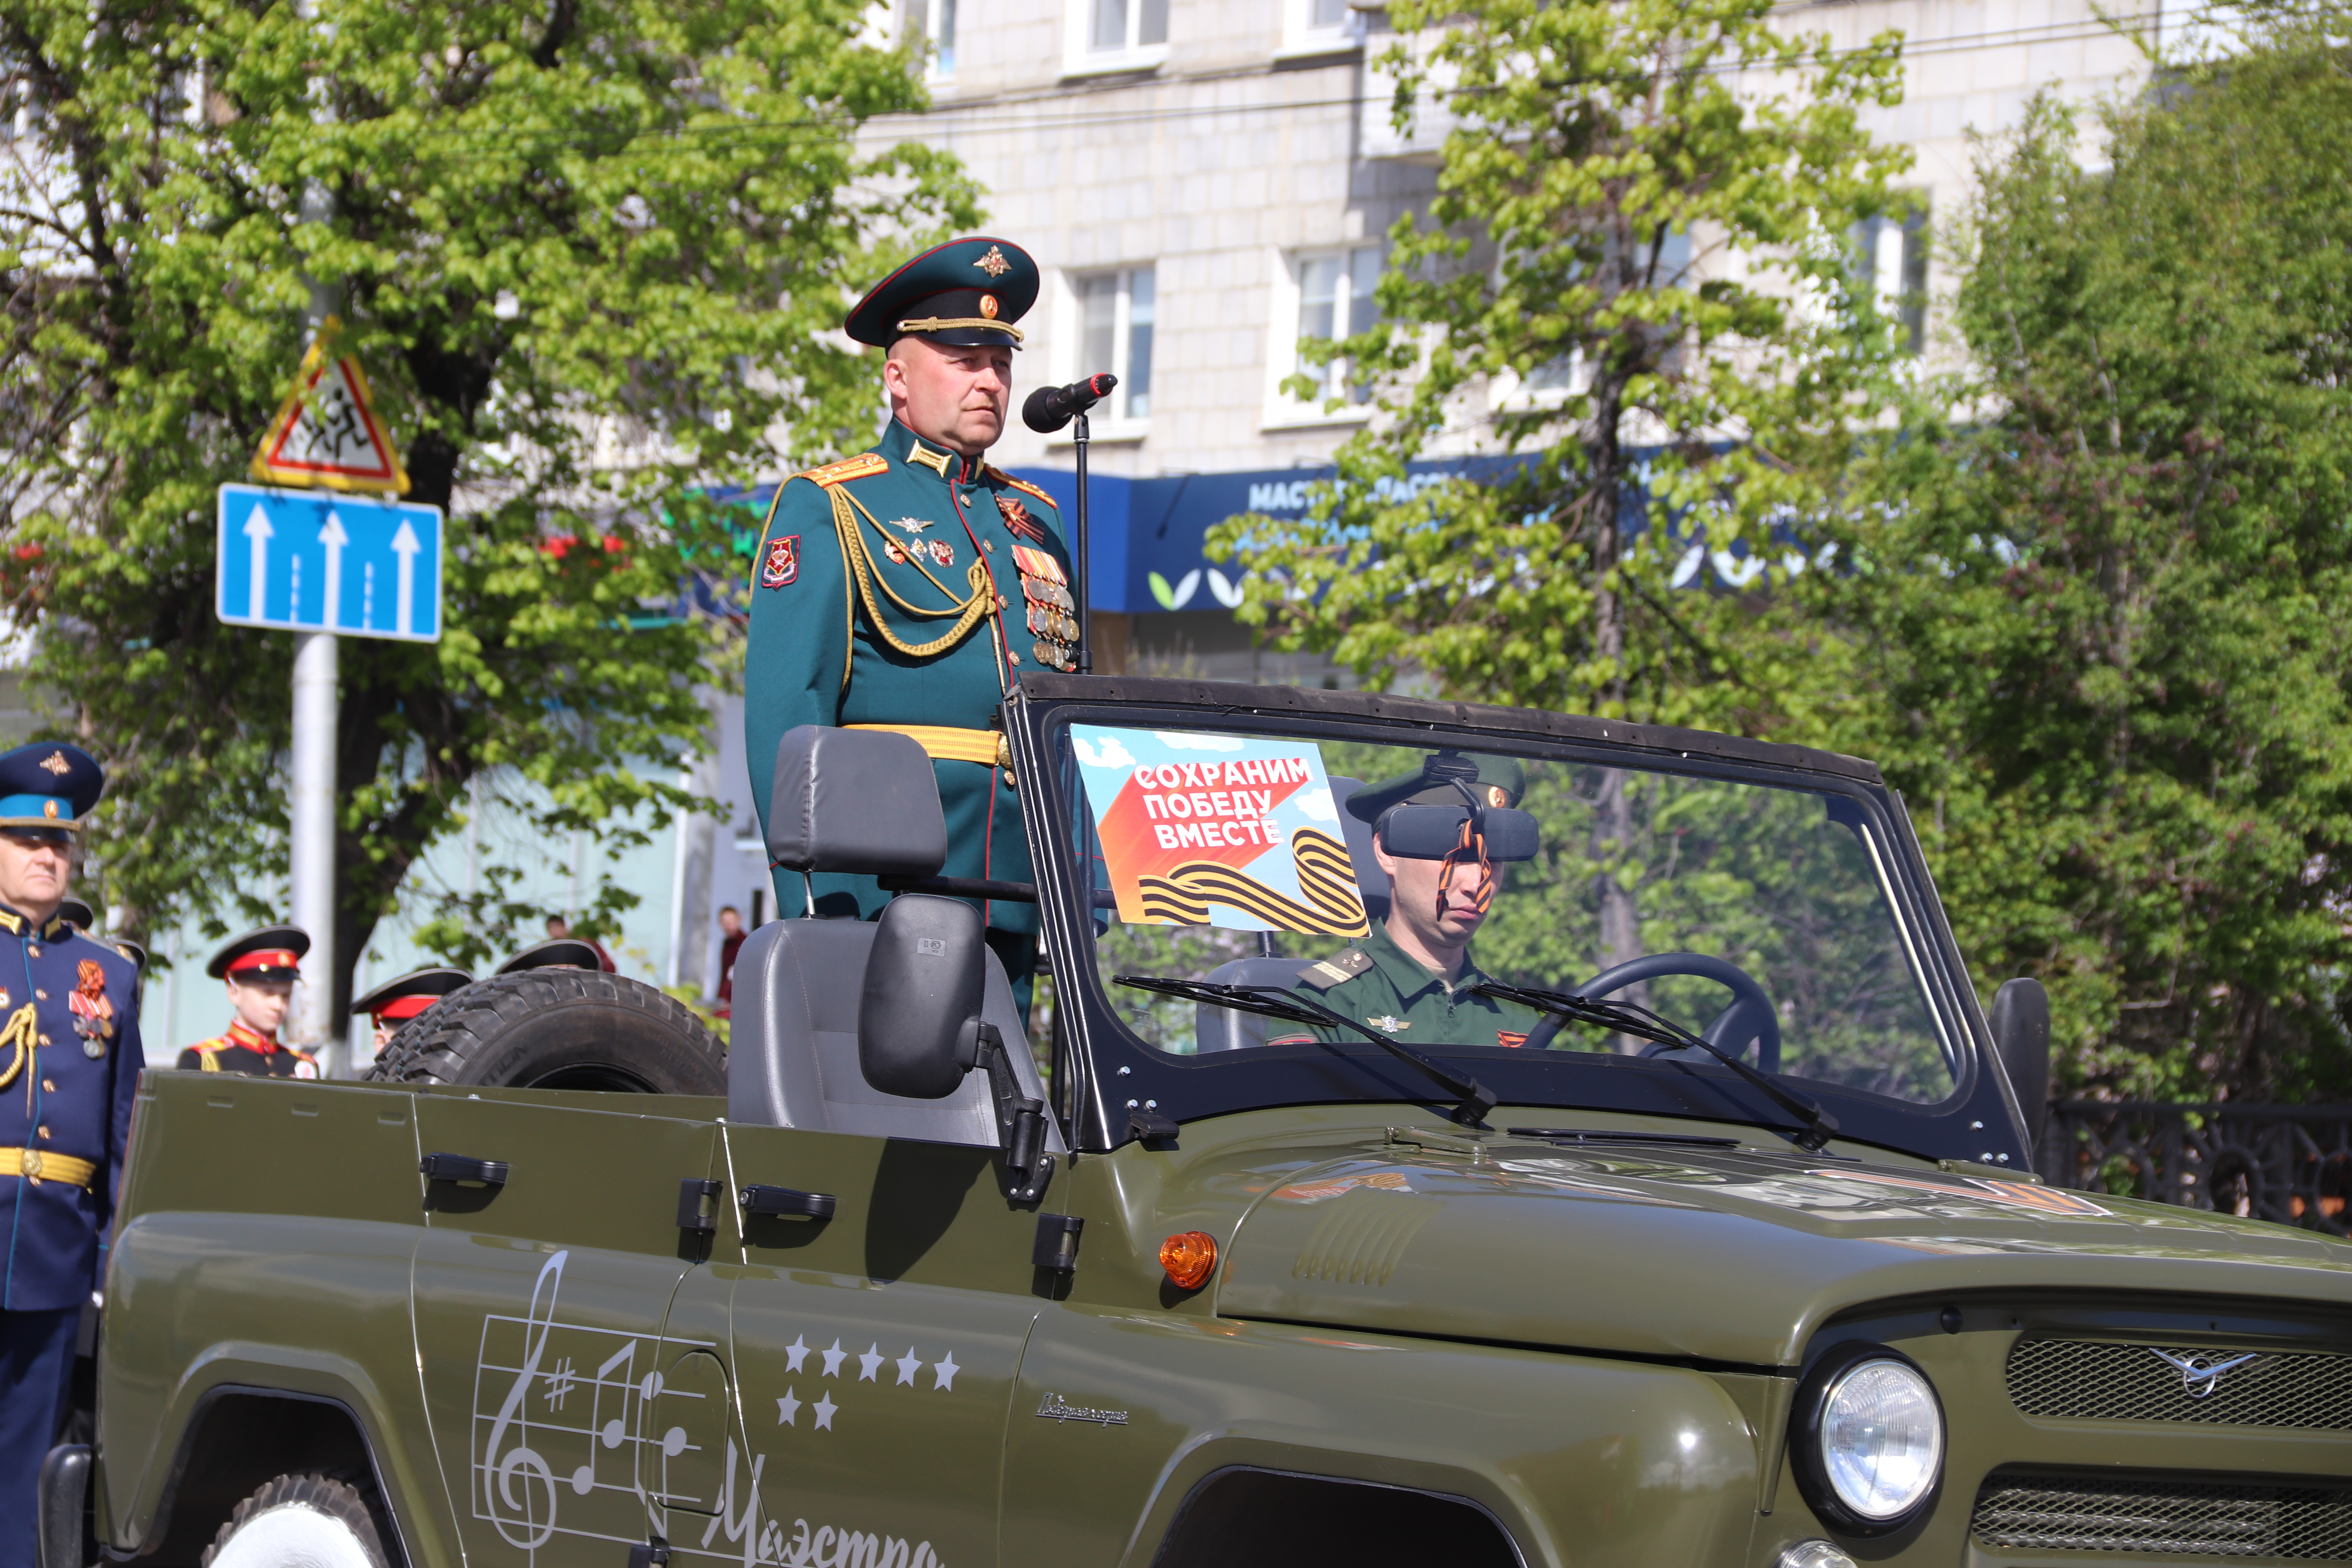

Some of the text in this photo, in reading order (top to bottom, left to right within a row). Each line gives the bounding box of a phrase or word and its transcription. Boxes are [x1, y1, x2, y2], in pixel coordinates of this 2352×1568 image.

[1135, 758, 1314, 789] СОХРАНИМ
[1143, 790, 1271, 819] ПОБЕДУ
[1154, 819, 1285, 849] ВМЕСТЕ
[701, 1435, 945, 1568] Маэстро
